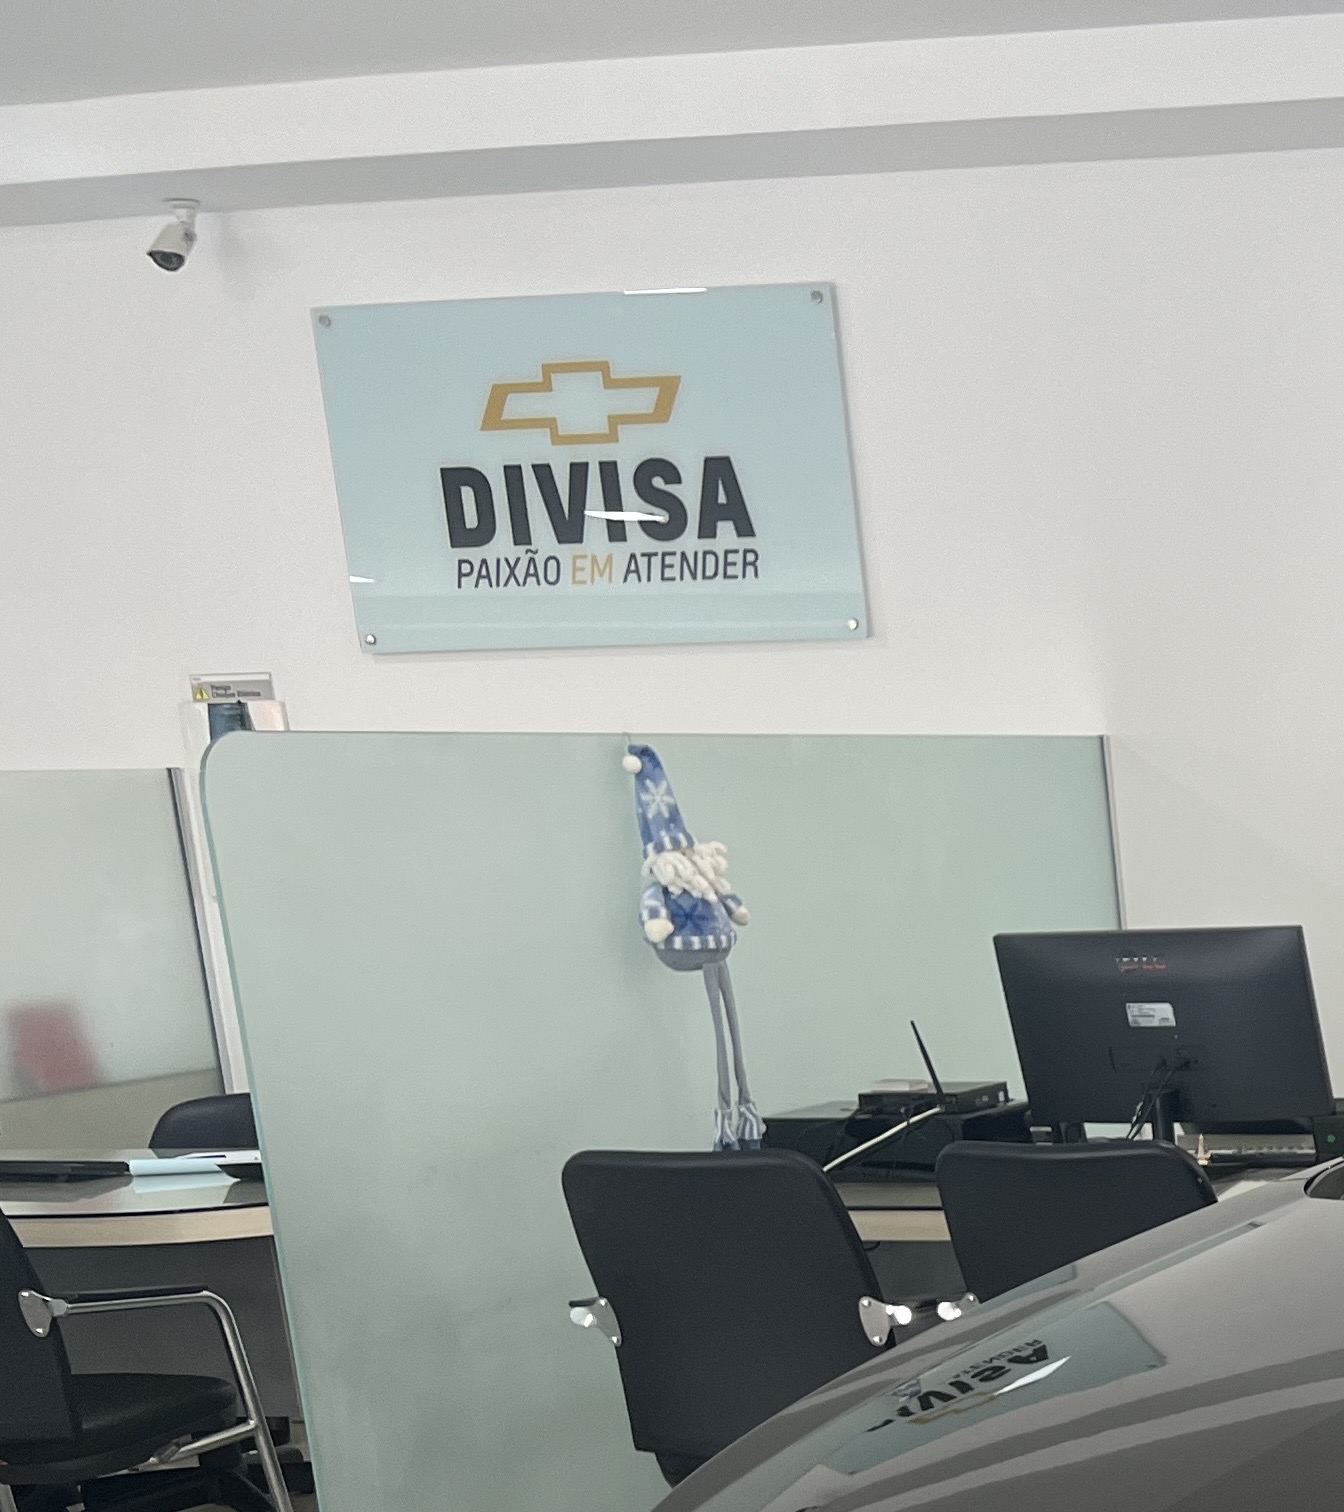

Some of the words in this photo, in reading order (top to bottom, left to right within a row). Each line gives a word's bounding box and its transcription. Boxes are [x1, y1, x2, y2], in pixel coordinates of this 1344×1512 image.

[440, 455, 756, 548] DIVISA
[457, 548, 561, 589] PAIXÃO
[571, 553, 614, 585] EM
[622, 548, 760, 584] ATENDER
